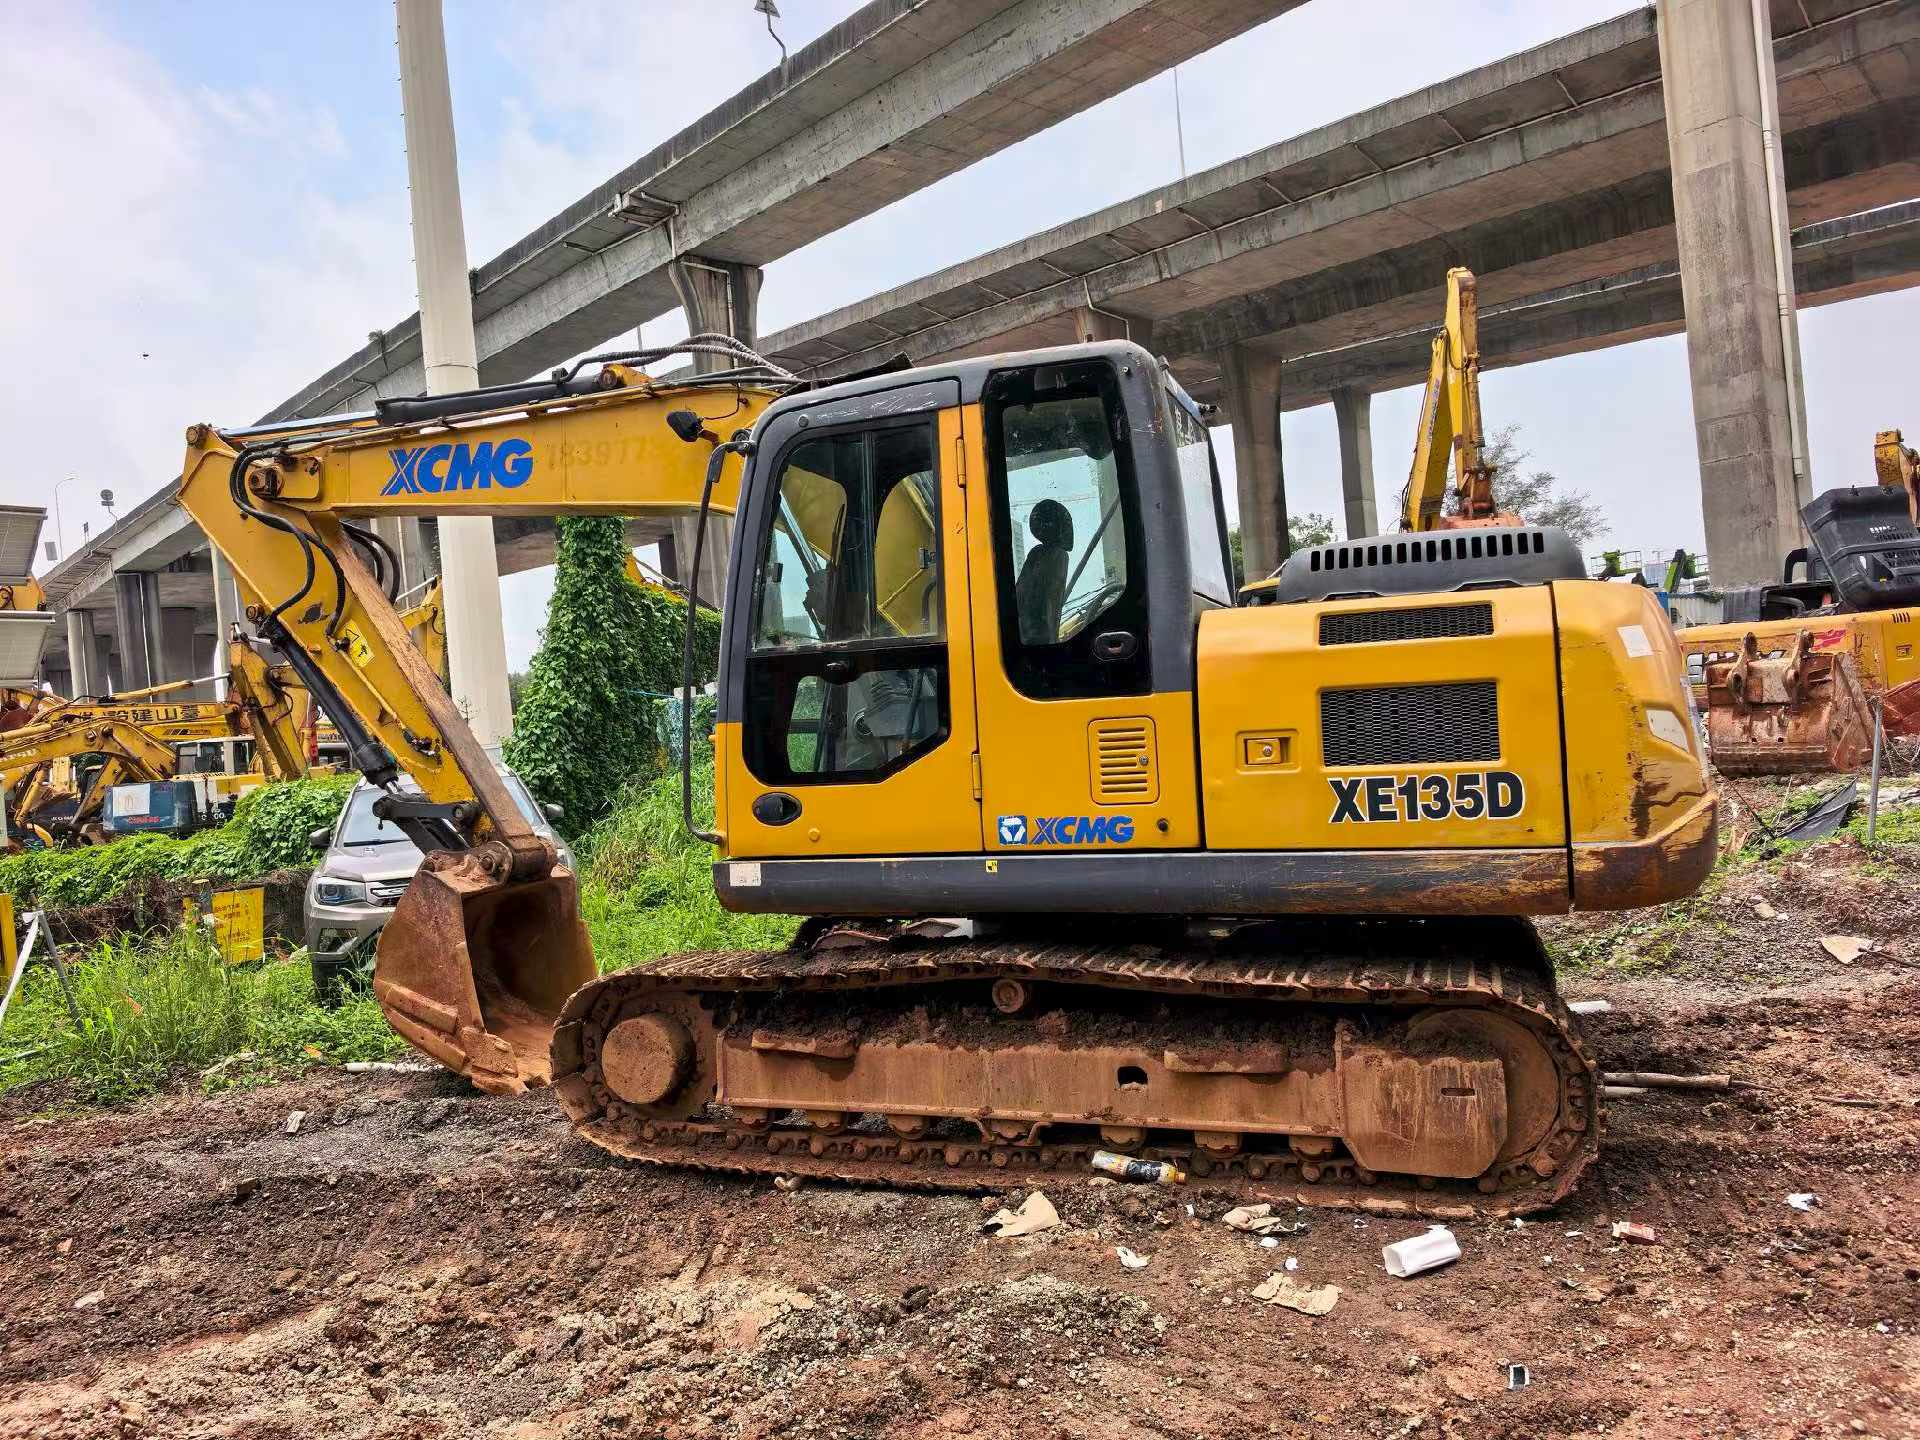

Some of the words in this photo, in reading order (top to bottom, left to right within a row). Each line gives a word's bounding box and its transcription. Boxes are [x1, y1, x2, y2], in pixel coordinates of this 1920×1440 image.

[380, 438, 533, 496] XCMG
[1327, 770, 1526, 824] XE135D
[1031, 816, 1135, 845] XCMG
